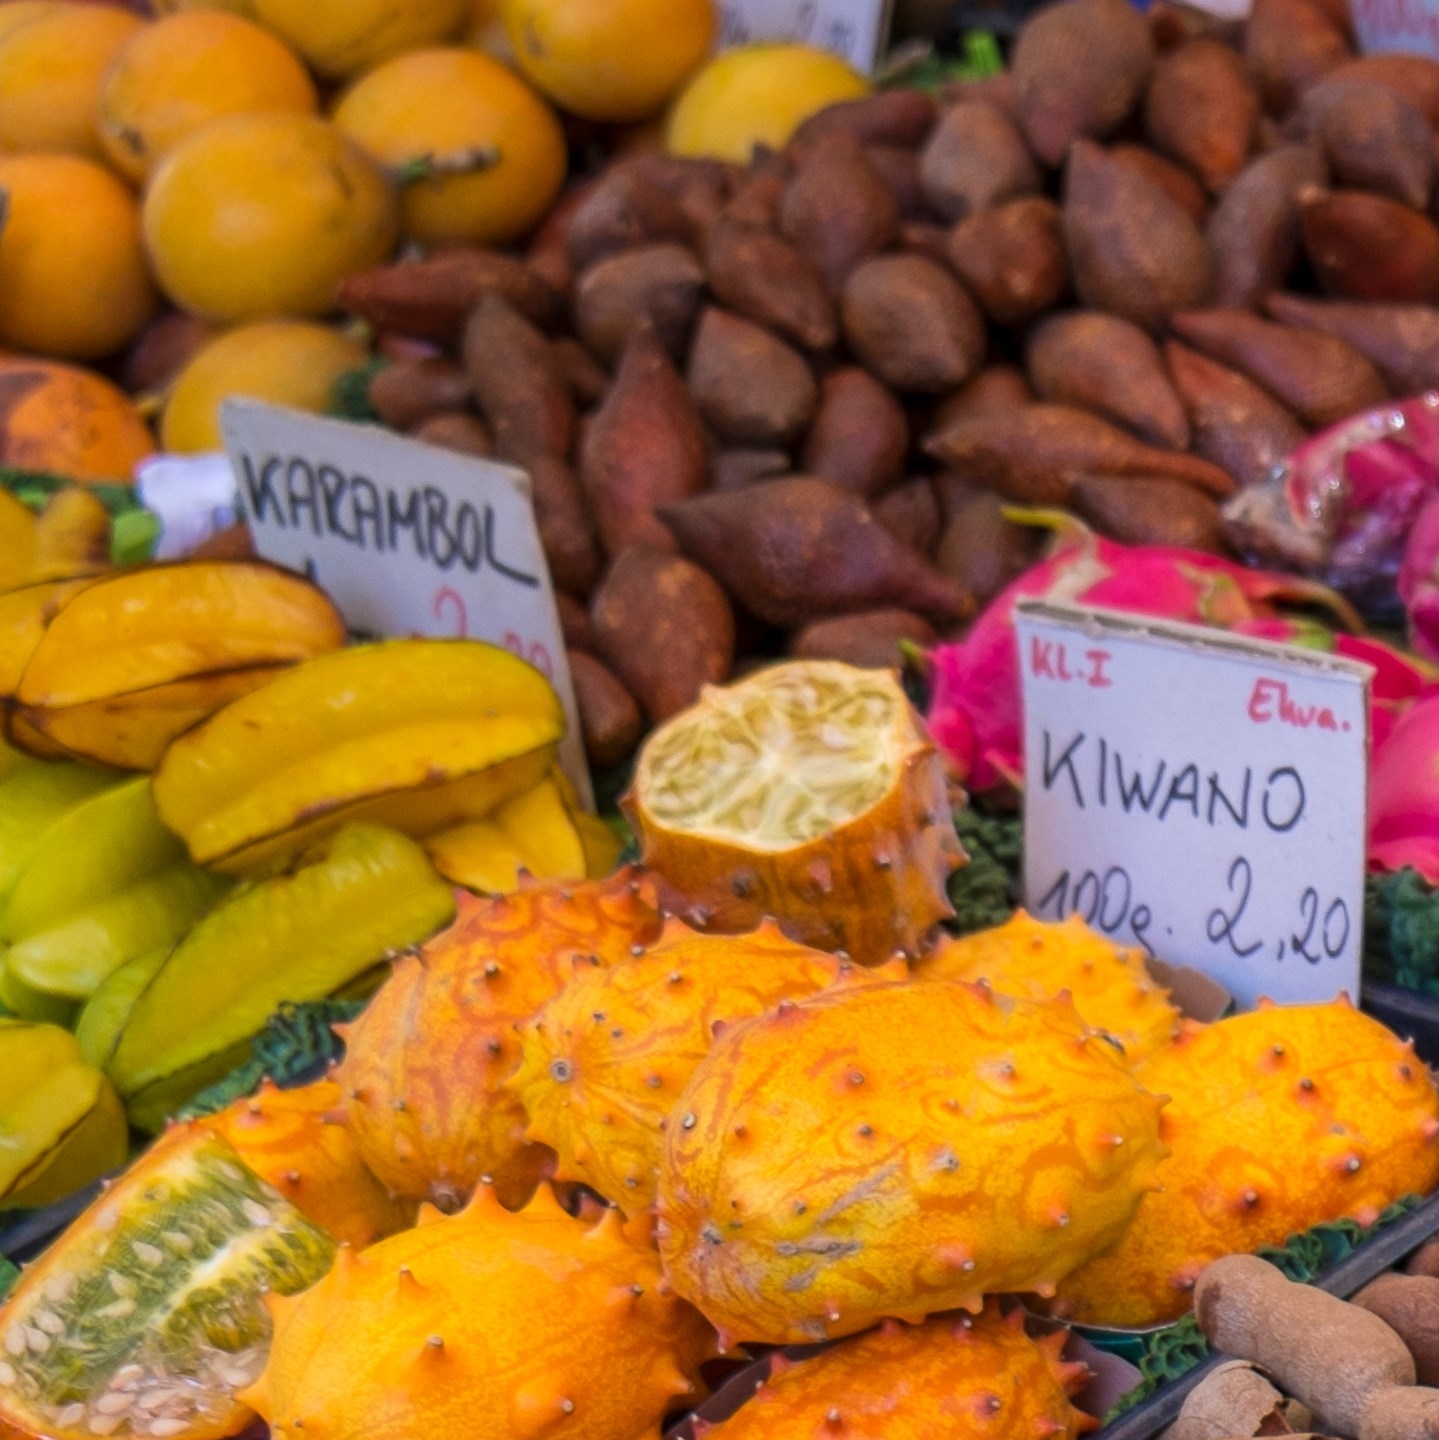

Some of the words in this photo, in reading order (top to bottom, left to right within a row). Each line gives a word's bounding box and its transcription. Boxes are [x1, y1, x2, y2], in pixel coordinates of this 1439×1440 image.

[242, 453, 539, 589] KARAMBOL
[1040, 730, 1306, 832] KIWANO
[1206, 856, 1351, 964] 2,20
